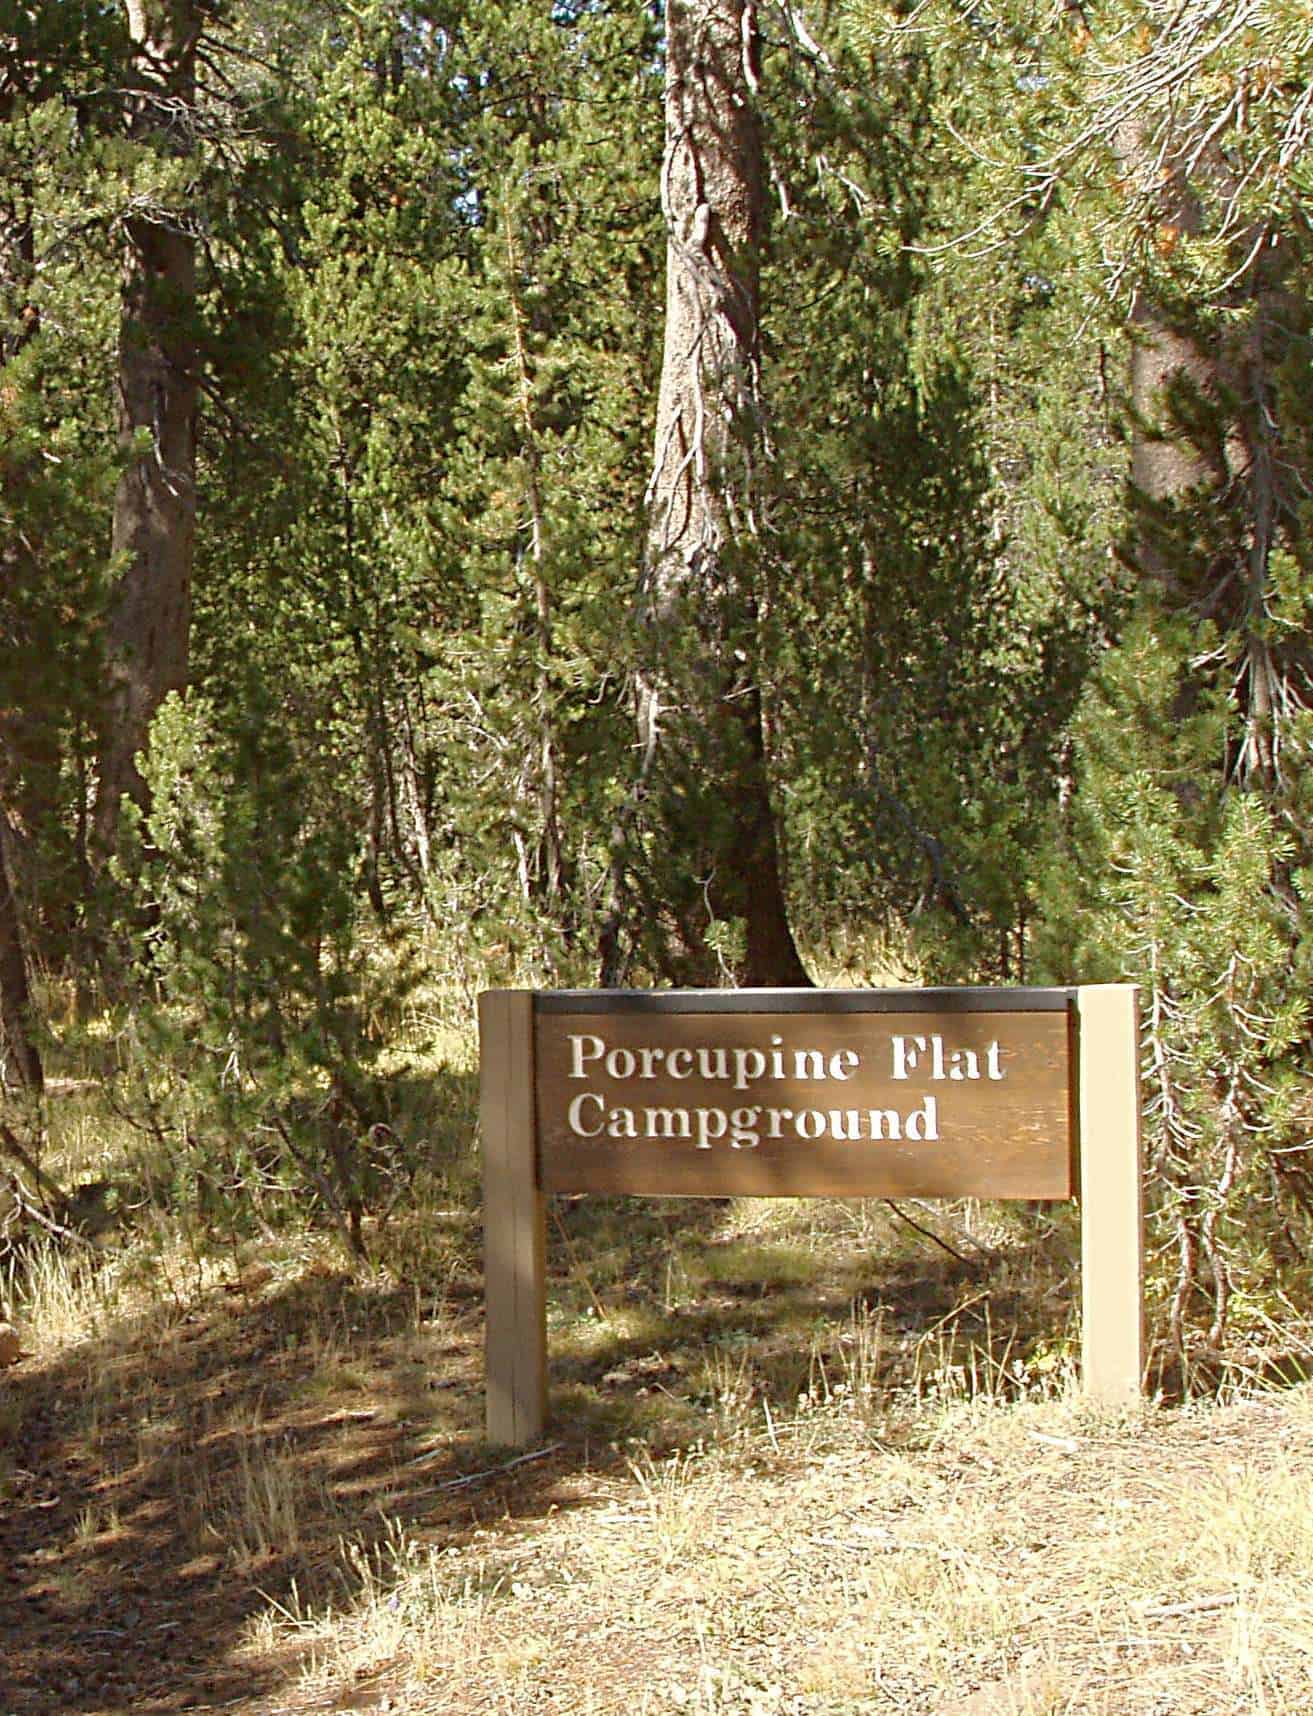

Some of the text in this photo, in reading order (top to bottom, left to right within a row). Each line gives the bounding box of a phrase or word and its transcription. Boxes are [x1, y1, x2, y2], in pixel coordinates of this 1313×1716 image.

[567, 1034, 1006, 1089] Porcupine Flat
[568, 1093, 939, 1149] Campground
